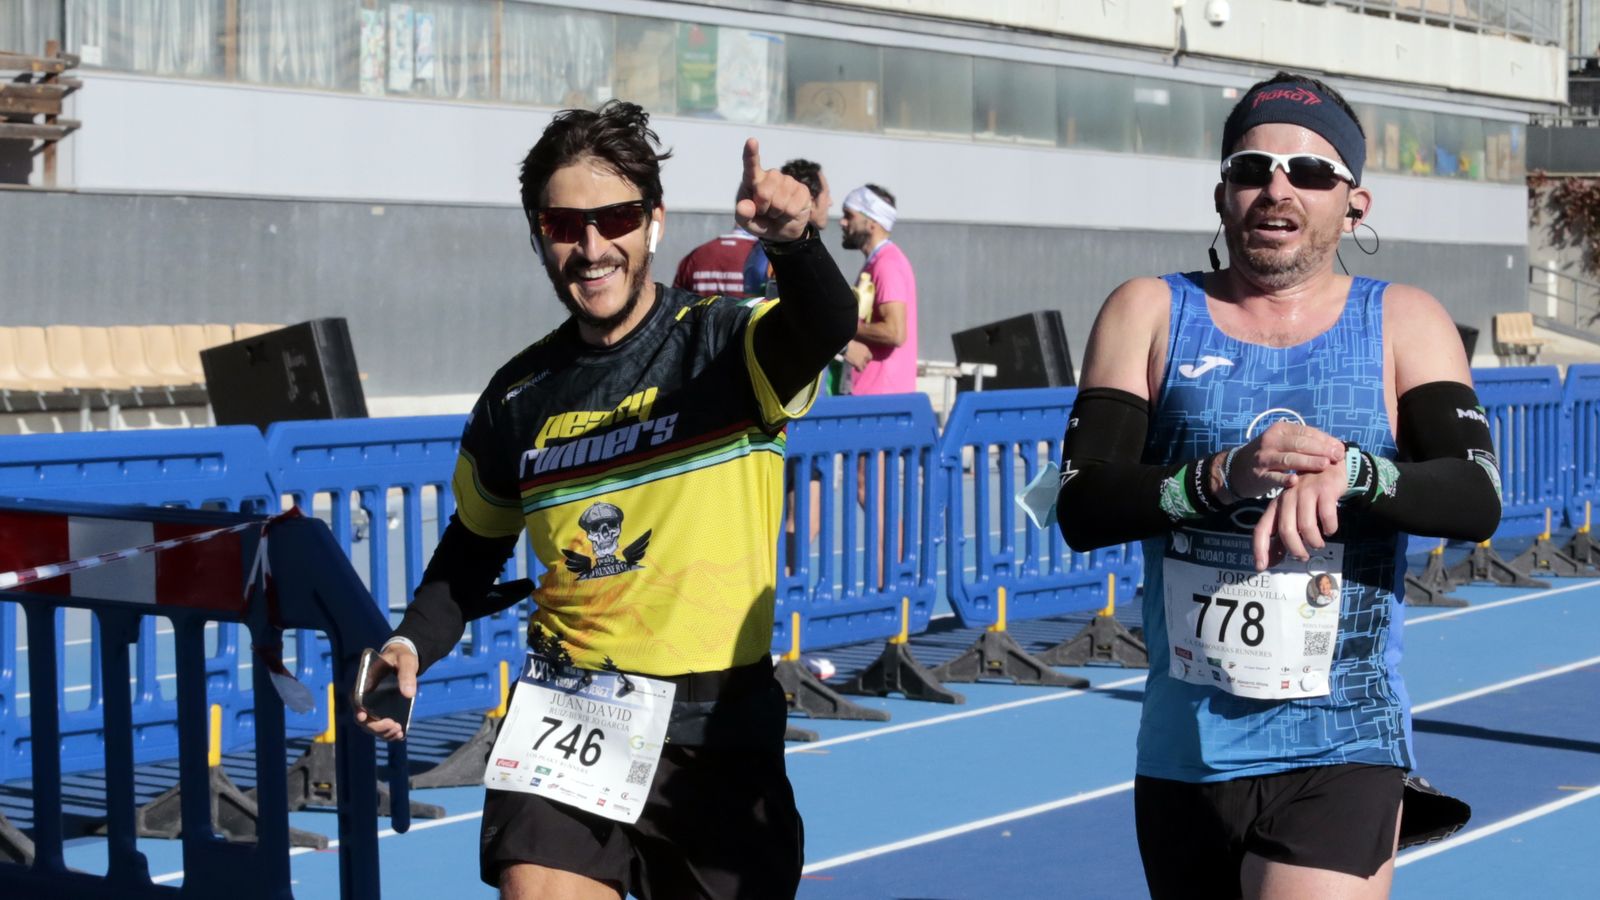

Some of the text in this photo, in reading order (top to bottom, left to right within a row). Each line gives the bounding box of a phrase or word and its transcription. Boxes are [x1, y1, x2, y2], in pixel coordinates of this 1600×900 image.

[1195, 548, 1256, 566] CIUDAD DE JER
[1215, 570, 1271, 589] JORGE
[1202, 583, 1288, 601] CABALLERO VILLA
[1192, 593, 1265, 647] 778
[549, 692, 632, 722] JUAN DAVID
[532, 716, 605, 767] 746
